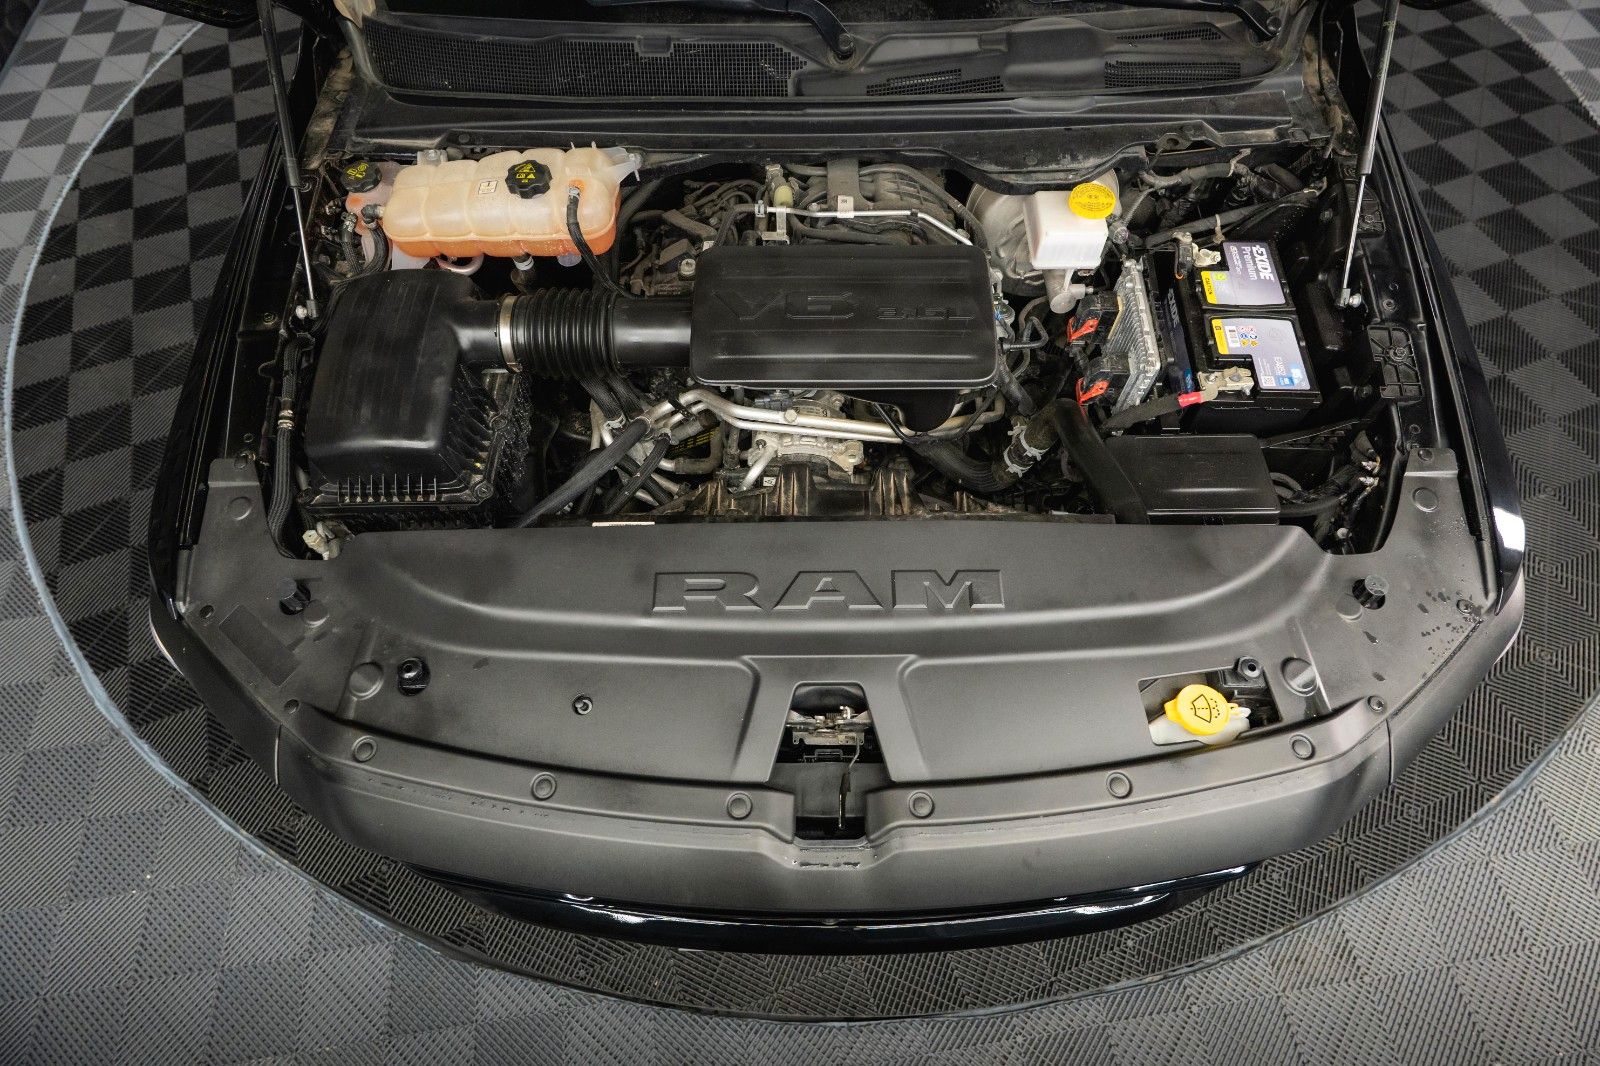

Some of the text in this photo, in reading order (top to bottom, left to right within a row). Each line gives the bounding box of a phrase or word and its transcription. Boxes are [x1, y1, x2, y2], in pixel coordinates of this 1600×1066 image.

[1241, 246, 1257, 280] Premium
[1252, 245, 1274, 281] EXIDE
[712, 290, 855, 320] V6
[1167, 288, 1179, 328] EXIDE
[652, 569, 1005, 611] RAM
